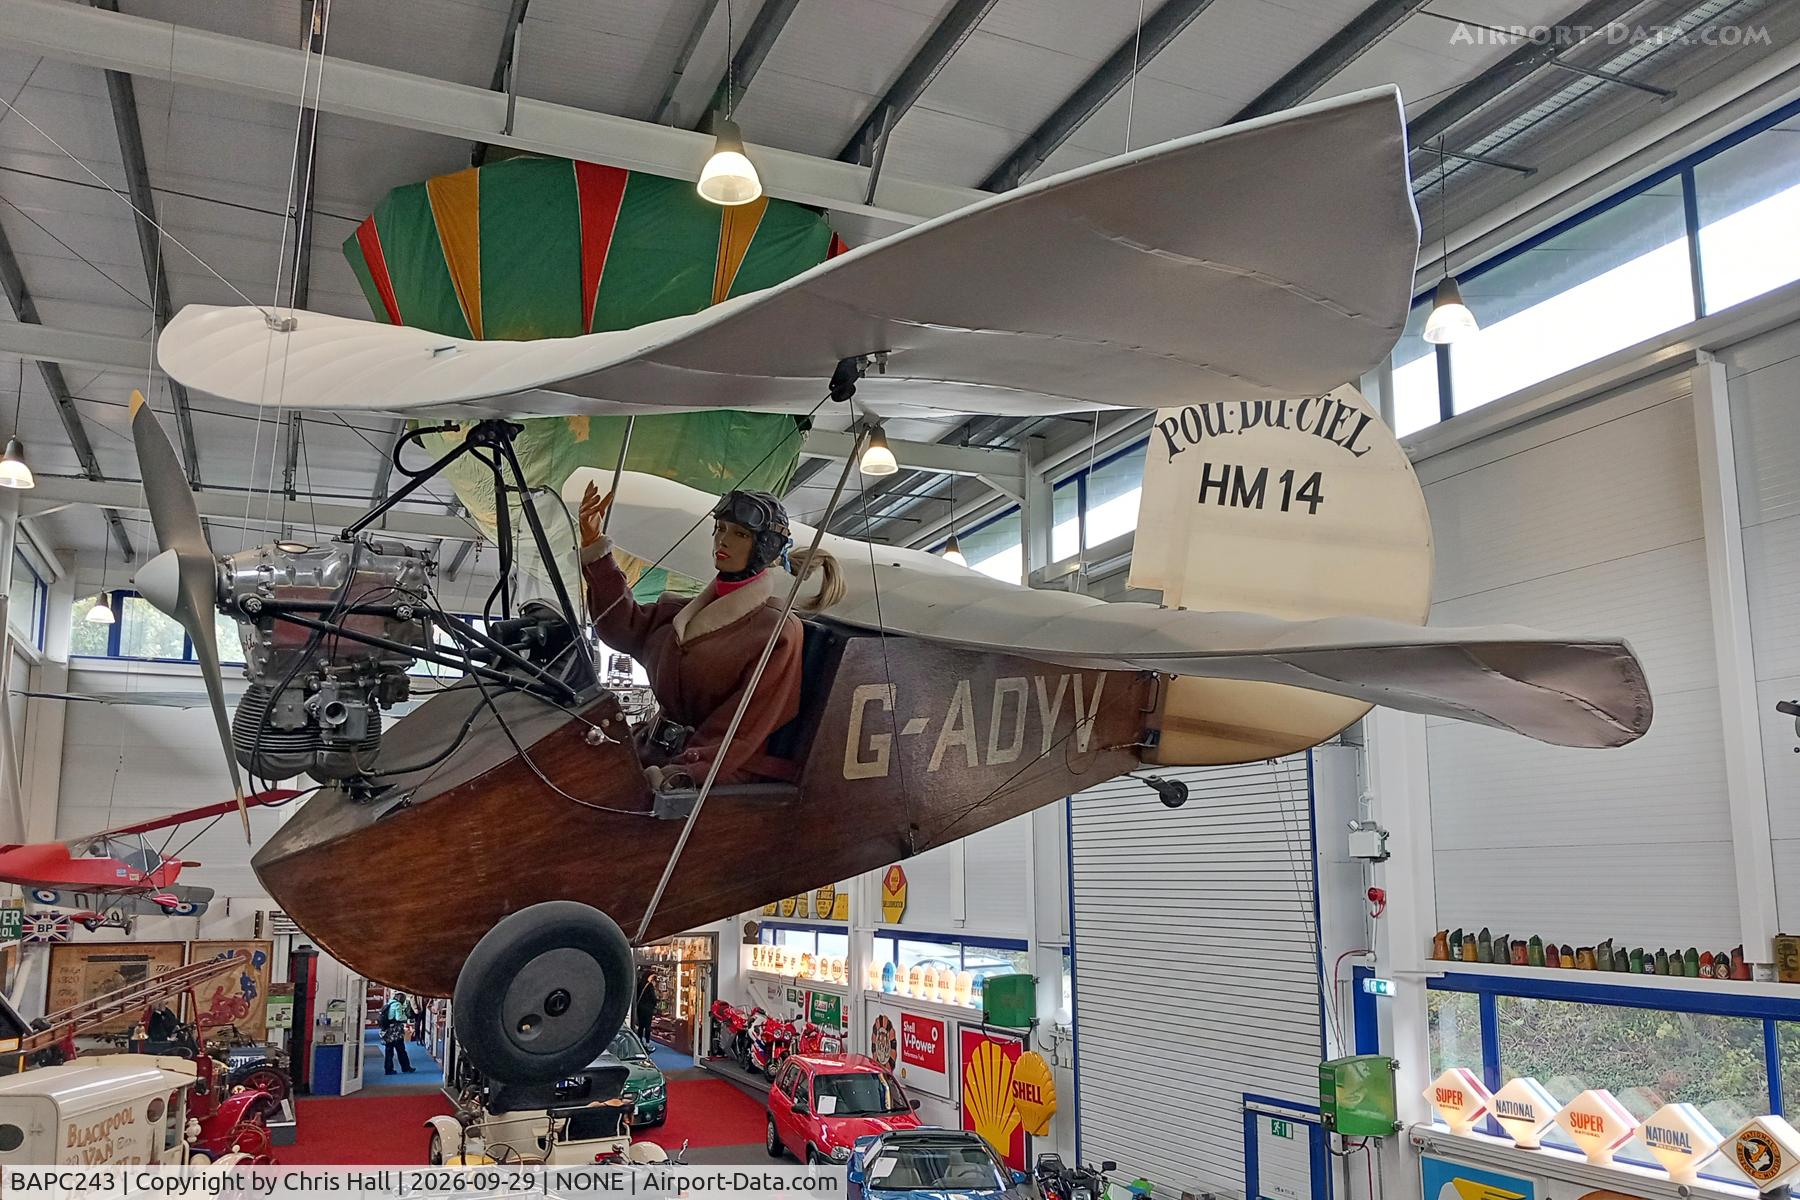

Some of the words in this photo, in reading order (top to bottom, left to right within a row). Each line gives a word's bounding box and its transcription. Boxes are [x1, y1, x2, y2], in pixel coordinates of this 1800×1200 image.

[1198, 463, 1269, 509] HM
[1279, 469, 1324, 515] 14
[843, 672, 1107, 780] G-ADYV
[38, 923, 53, 933] BP
[904, 1032, 936, 1054] V-Power
[1012, 1079, 1043, 1106] SHELL
[1436, 1087, 1463, 1106] SUPER
[1495, 1100, 1535, 1118] NATIONAL
[66, 1107, 135, 1148] BLACKPOOL
[1570, 1111, 1604, 1133] SUPER
[1646, 1125, 1692, 1149] NATIONAL
